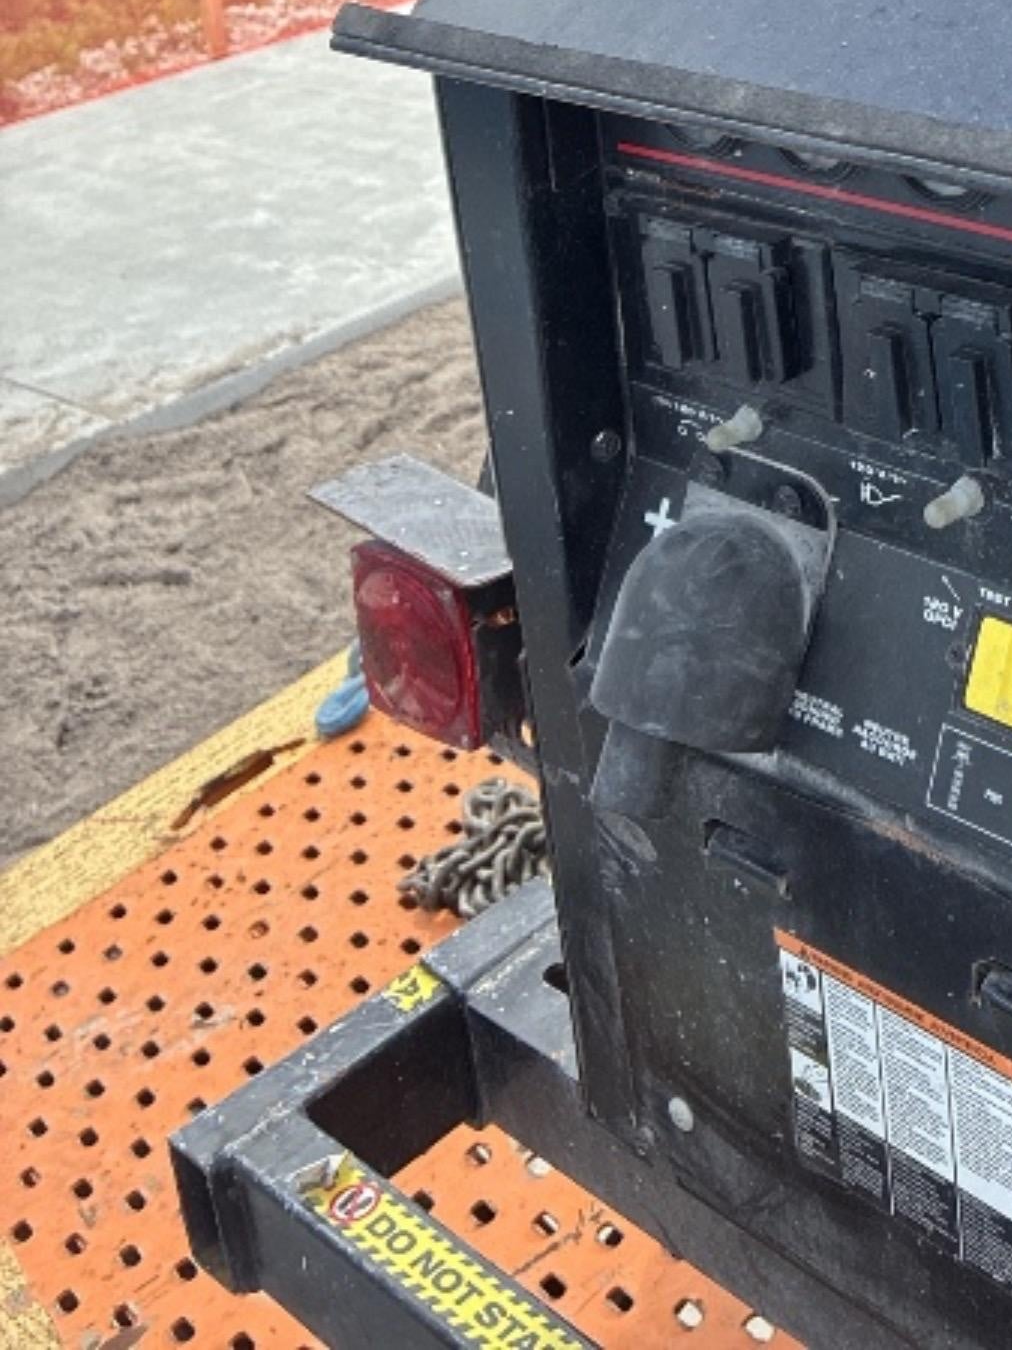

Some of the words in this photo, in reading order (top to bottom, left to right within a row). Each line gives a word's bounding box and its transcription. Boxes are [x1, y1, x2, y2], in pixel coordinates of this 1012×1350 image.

[979, 586, 1010, 607] TEST
[366, 1212, 418, 1255] DO
[411, 1251, 485, 1305] NOT
